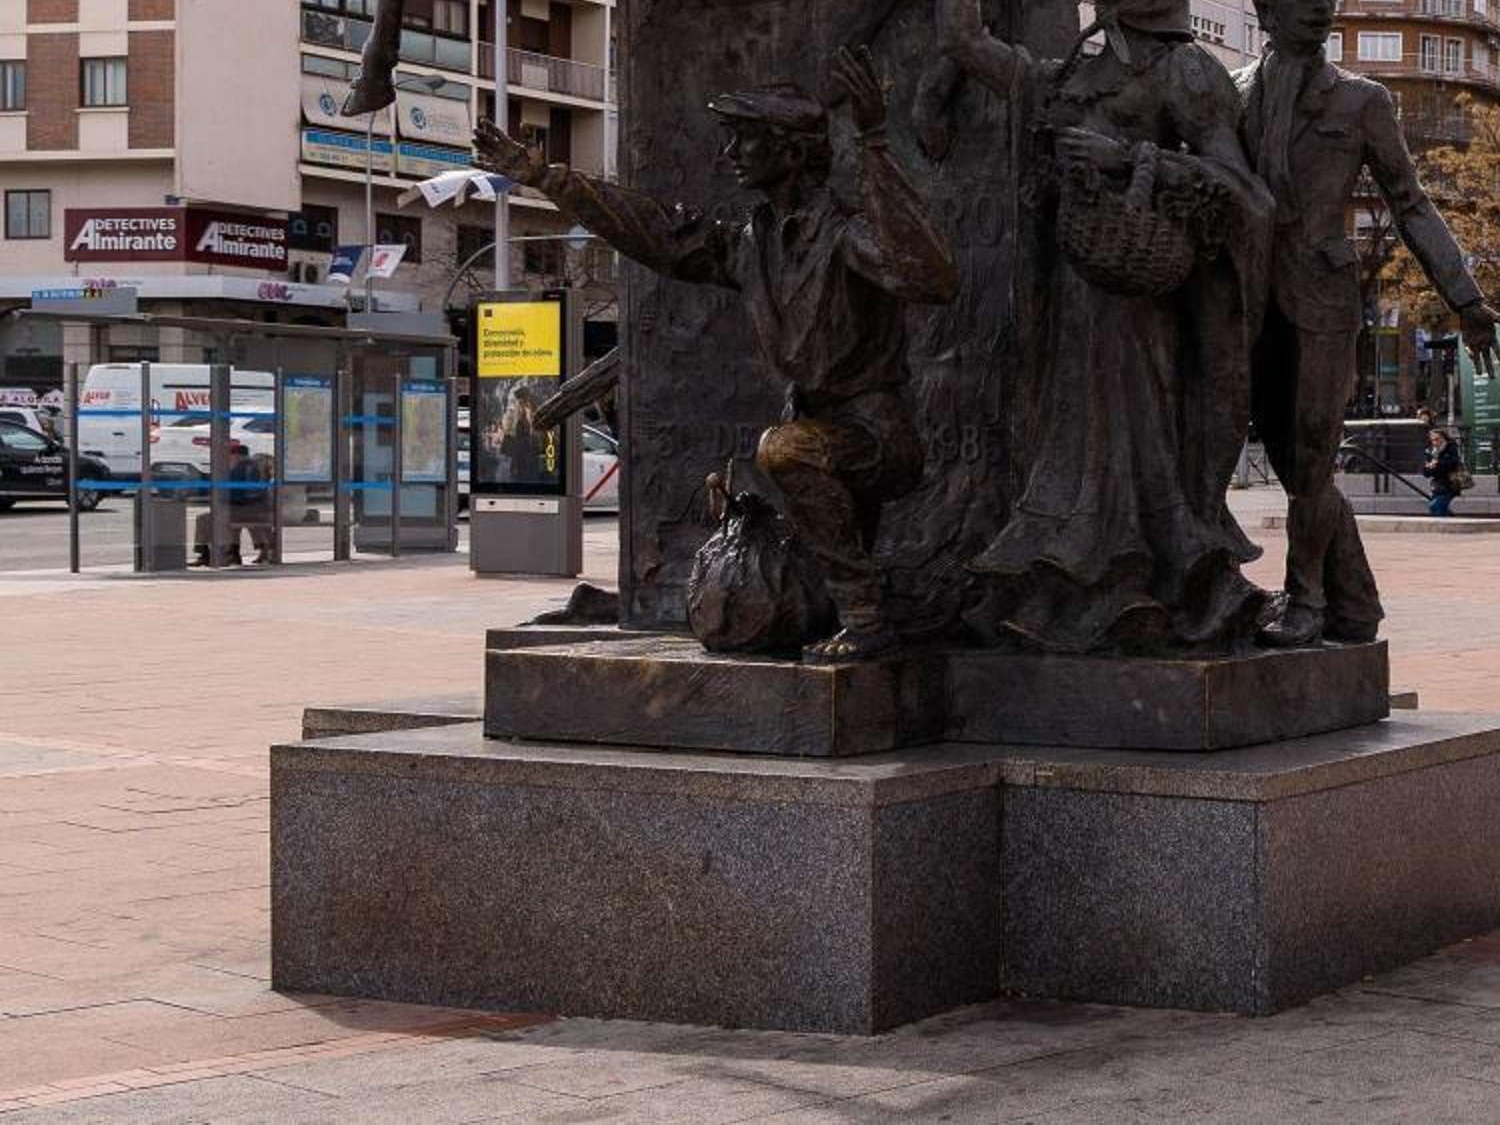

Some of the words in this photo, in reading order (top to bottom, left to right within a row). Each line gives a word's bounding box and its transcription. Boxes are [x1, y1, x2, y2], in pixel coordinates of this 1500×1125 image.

[71, 219, 177, 251] Almirante
[96, 218, 176, 230] DETECTIVES
[219, 222, 285, 241] DETECTIVES
[196, 221, 286, 260] Almirante
